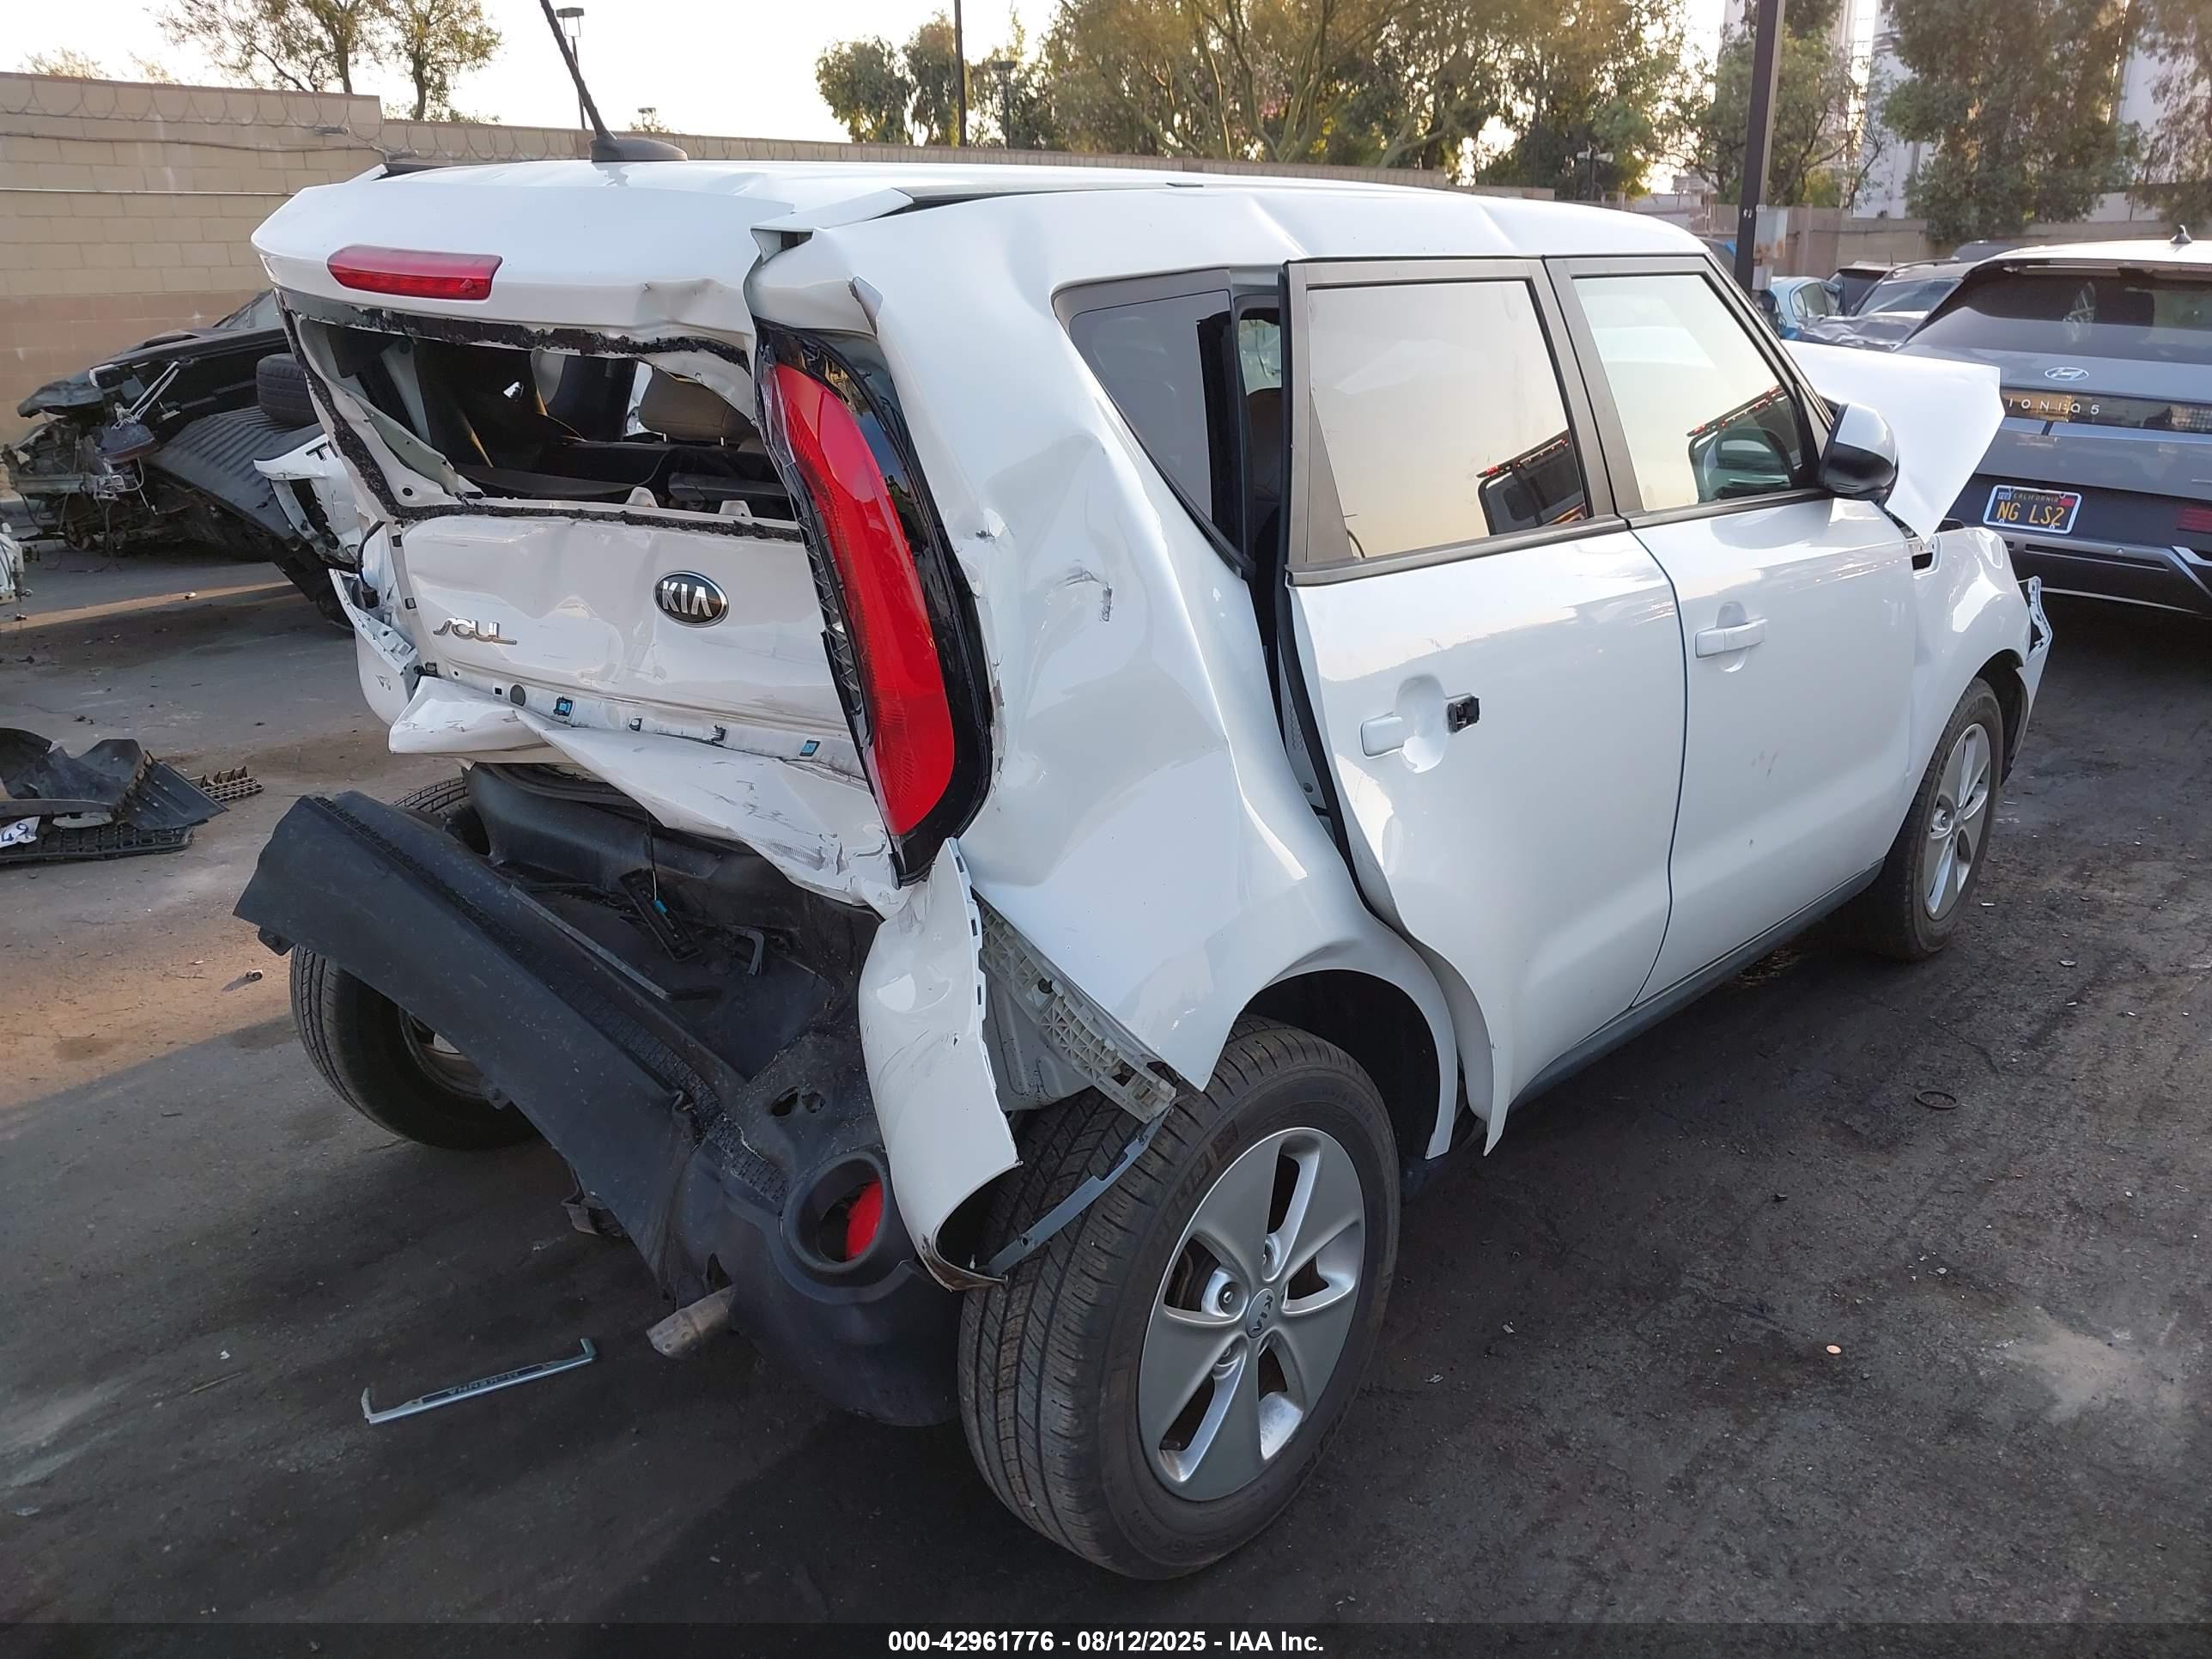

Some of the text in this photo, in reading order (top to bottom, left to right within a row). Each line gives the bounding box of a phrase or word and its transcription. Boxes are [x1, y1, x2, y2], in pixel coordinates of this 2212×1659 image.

[2090, 404, 2100, 416] 5
[1996, 501, 2066, 526] NG LS2
[661, 579, 714, 617] KIA
[1251, 1293, 1274, 1333] KIA
